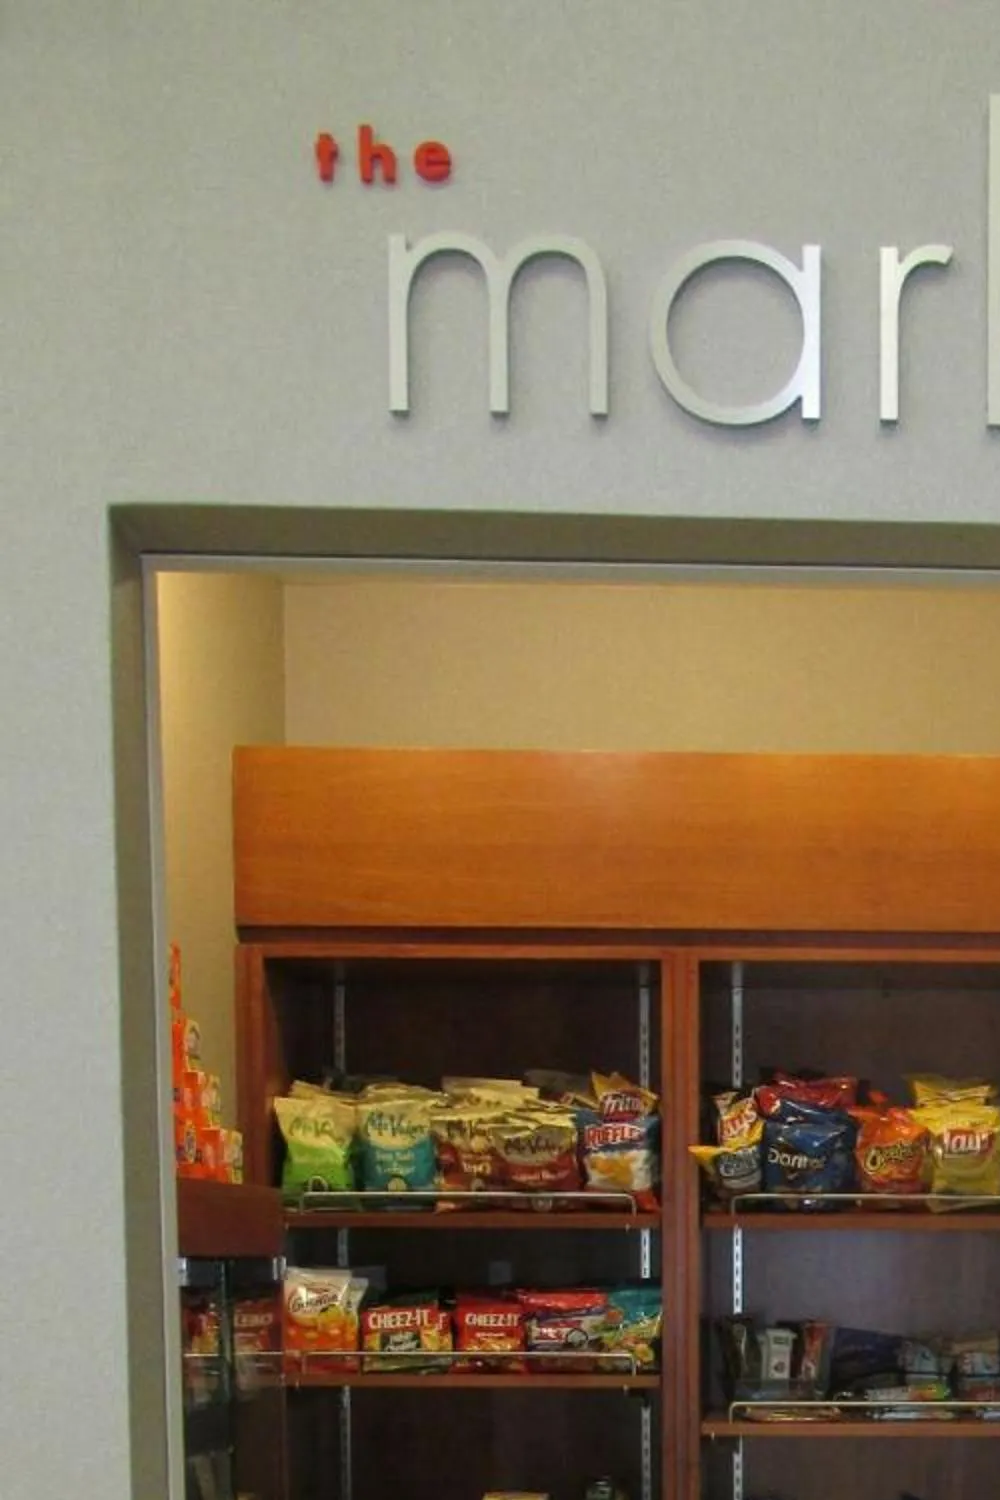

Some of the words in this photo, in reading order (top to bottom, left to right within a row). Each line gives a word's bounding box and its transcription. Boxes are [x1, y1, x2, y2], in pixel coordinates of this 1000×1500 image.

[315, 125, 452, 184] the
[367, 1308, 432, 1330] CHEEZ-IT
[465, 1313, 520, 1327] CHEEZ-IT
